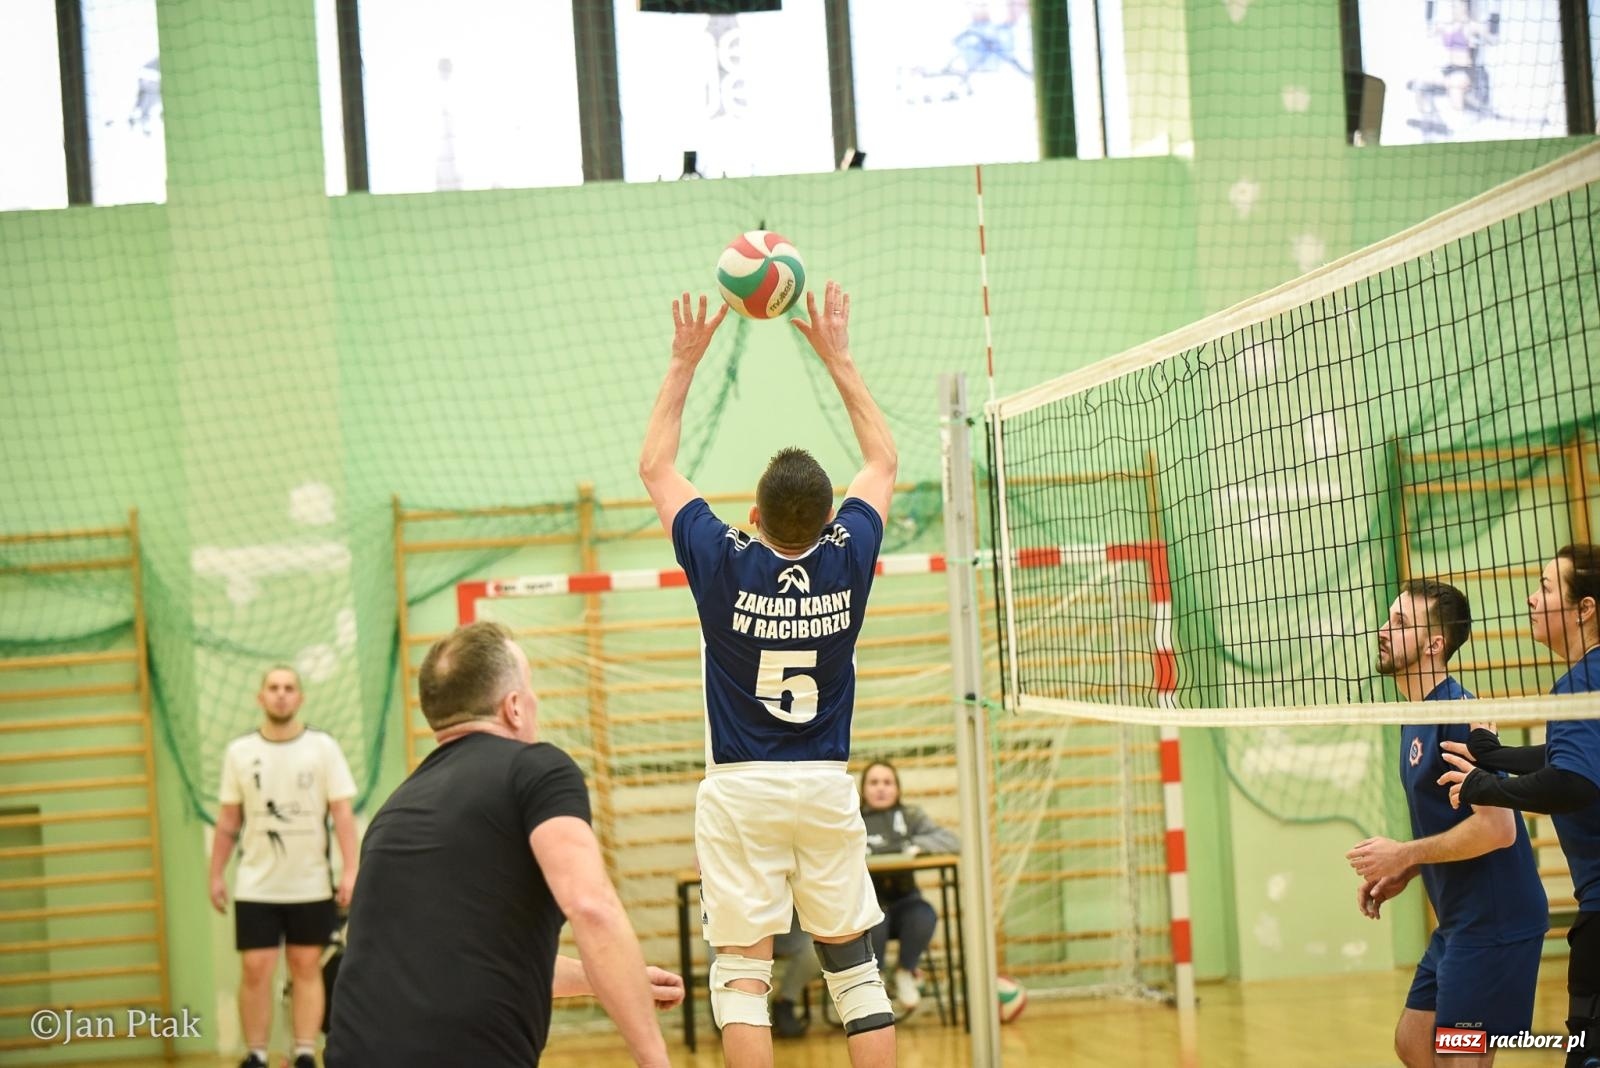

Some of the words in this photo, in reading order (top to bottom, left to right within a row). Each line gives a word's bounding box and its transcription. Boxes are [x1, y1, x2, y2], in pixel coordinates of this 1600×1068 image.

[769, 279, 794, 312] molten
[734, 590, 796, 616] ZAKŁAD
[800, 589, 851, 616] KARNY
[732, 612, 753, 634] W
[754, 611, 850, 639] RACIBORZU
[755, 650, 819, 724] 5
